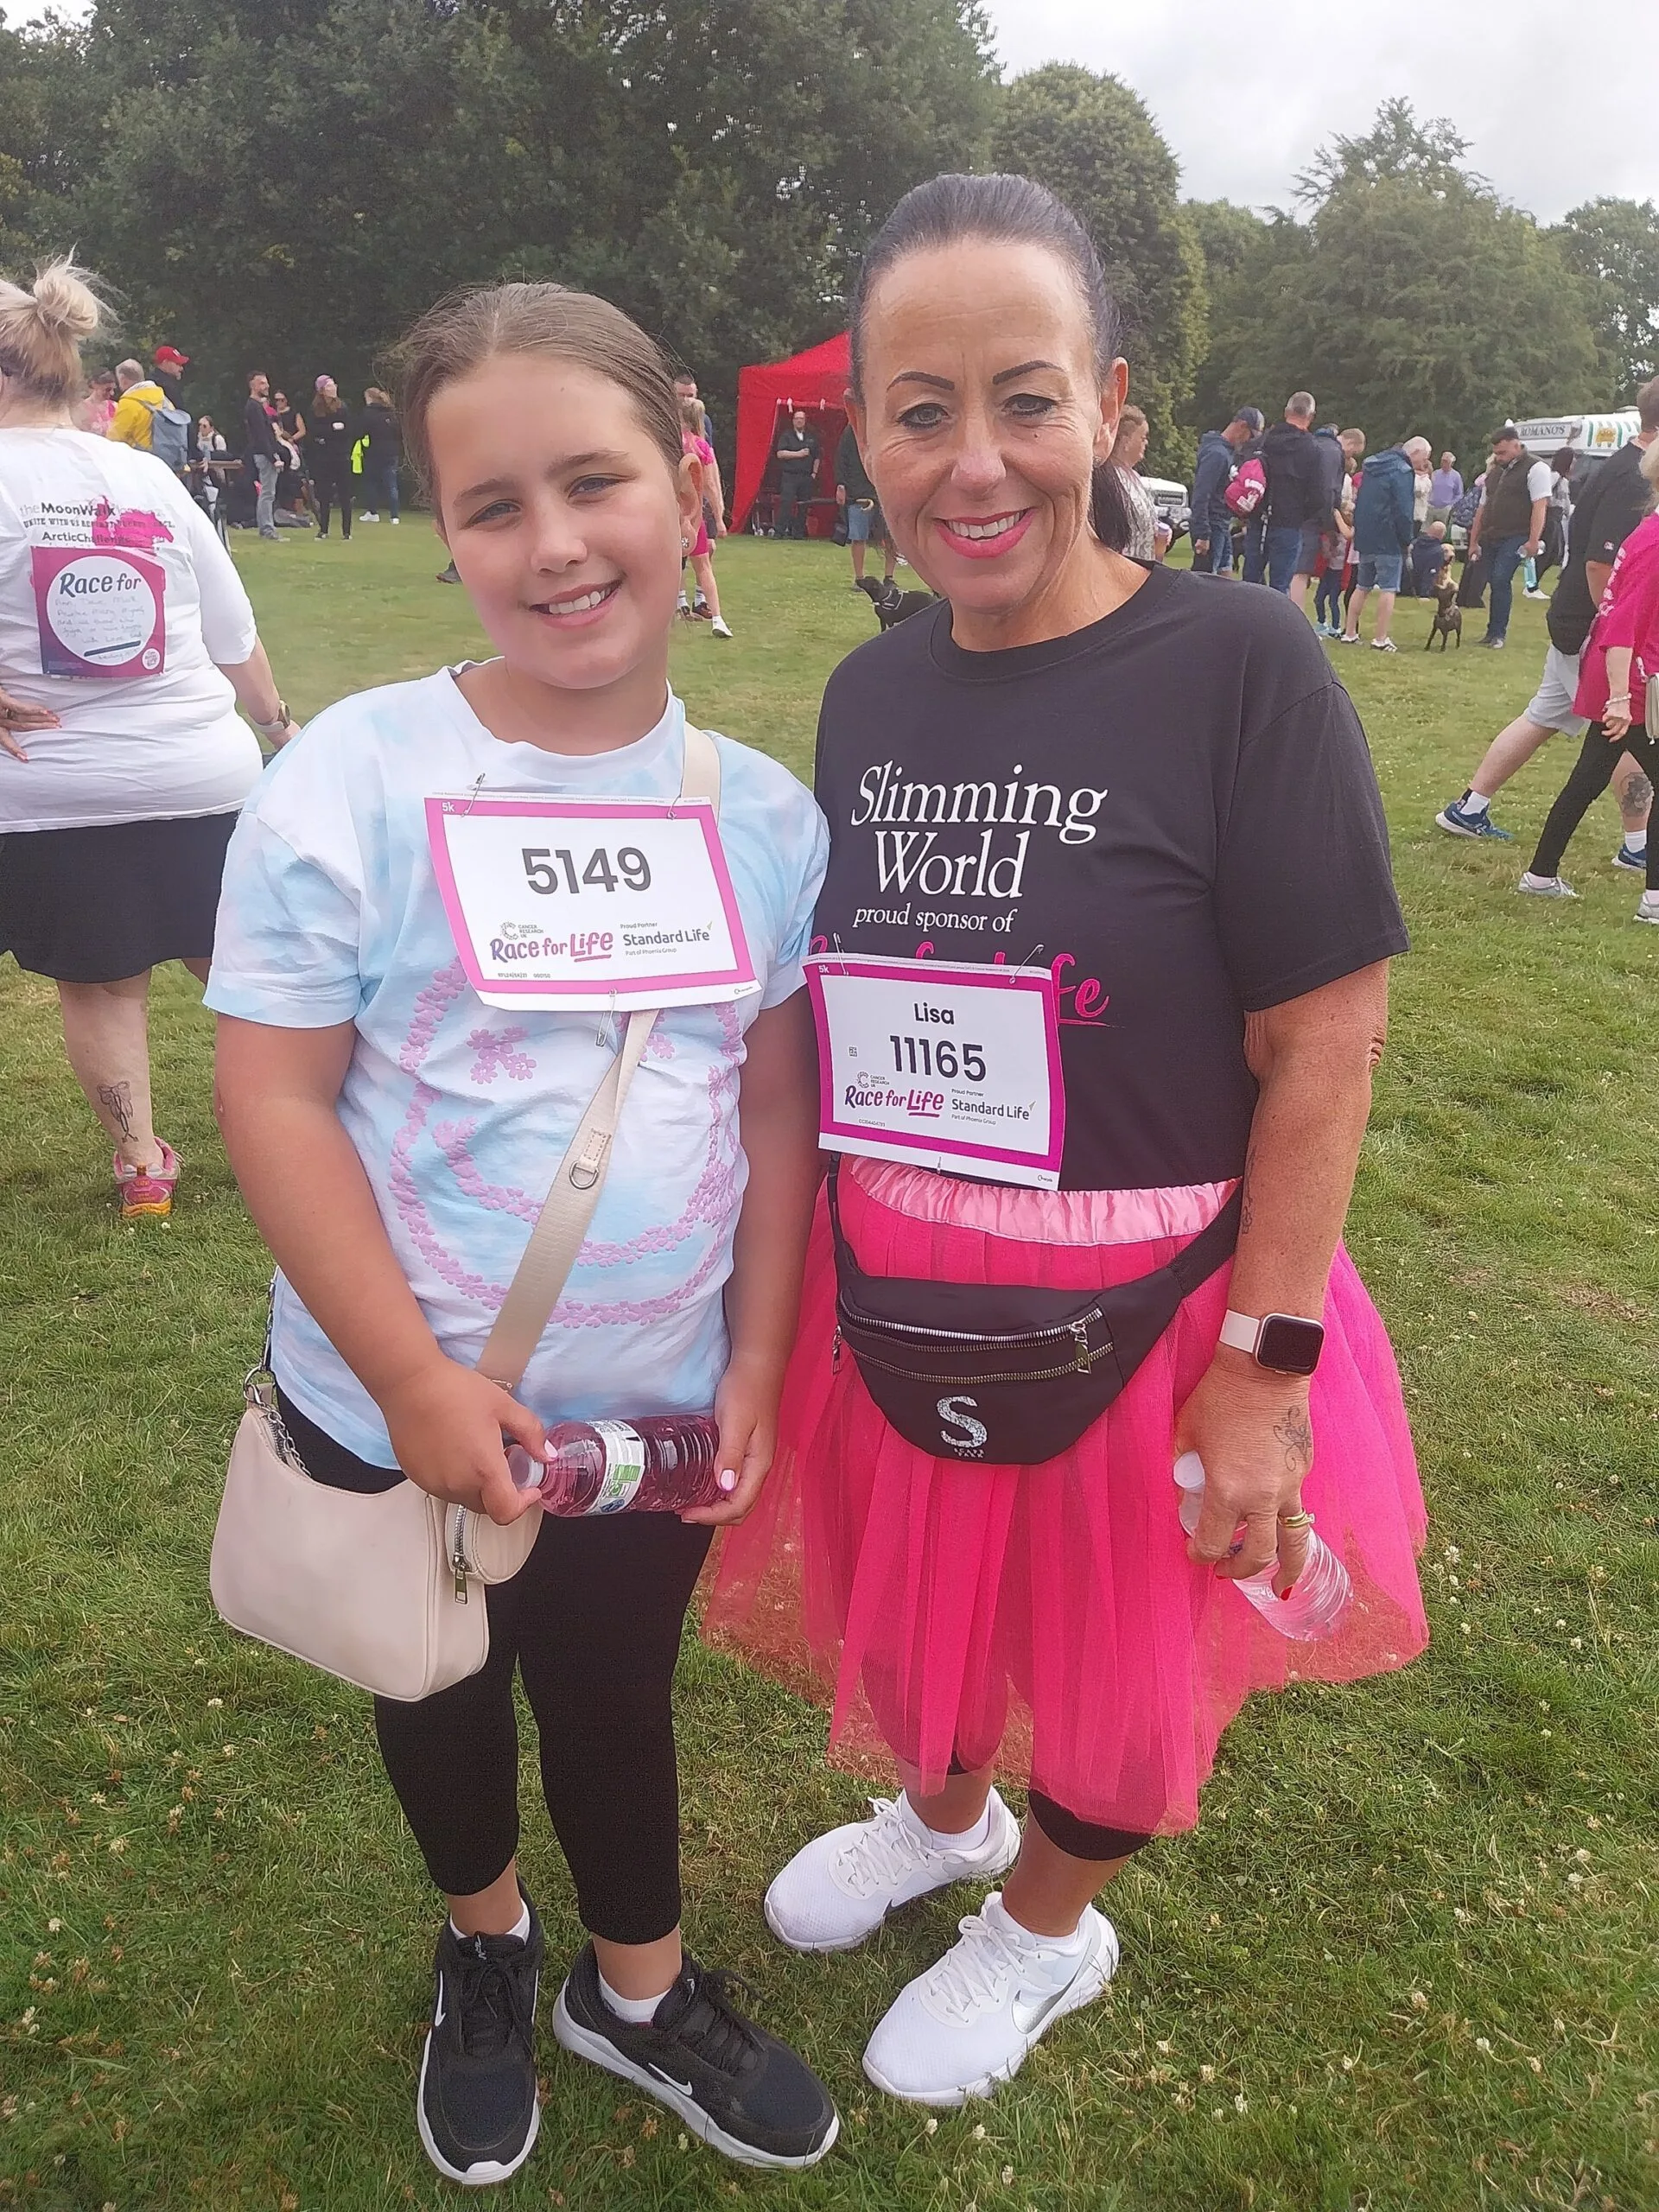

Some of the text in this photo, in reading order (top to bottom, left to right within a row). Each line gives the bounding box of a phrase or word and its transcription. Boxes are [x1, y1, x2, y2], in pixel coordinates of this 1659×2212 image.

[60, 572, 142, 598] Race for
[442, 801, 455, 812] 5k
[851, 760, 1109, 844] Slimming
[522, 847, 652, 894] 5149
[875, 829, 1030, 898] World
[852, 902, 1017, 932] proud sponsor of
[489, 931, 613, 963] Race for Life
[623, 928, 710, 947] Standard Life
[818, 964, 830, 974] 5k
[914, 1002, 955, 1025] Lisa
[890, 1035, 987, 1082] 11165
[844, 1084, 944, 1112] Race for Life
[951, 1098, 1030, 1120] Standard Life
[937, 1395, 988, 1448] S
